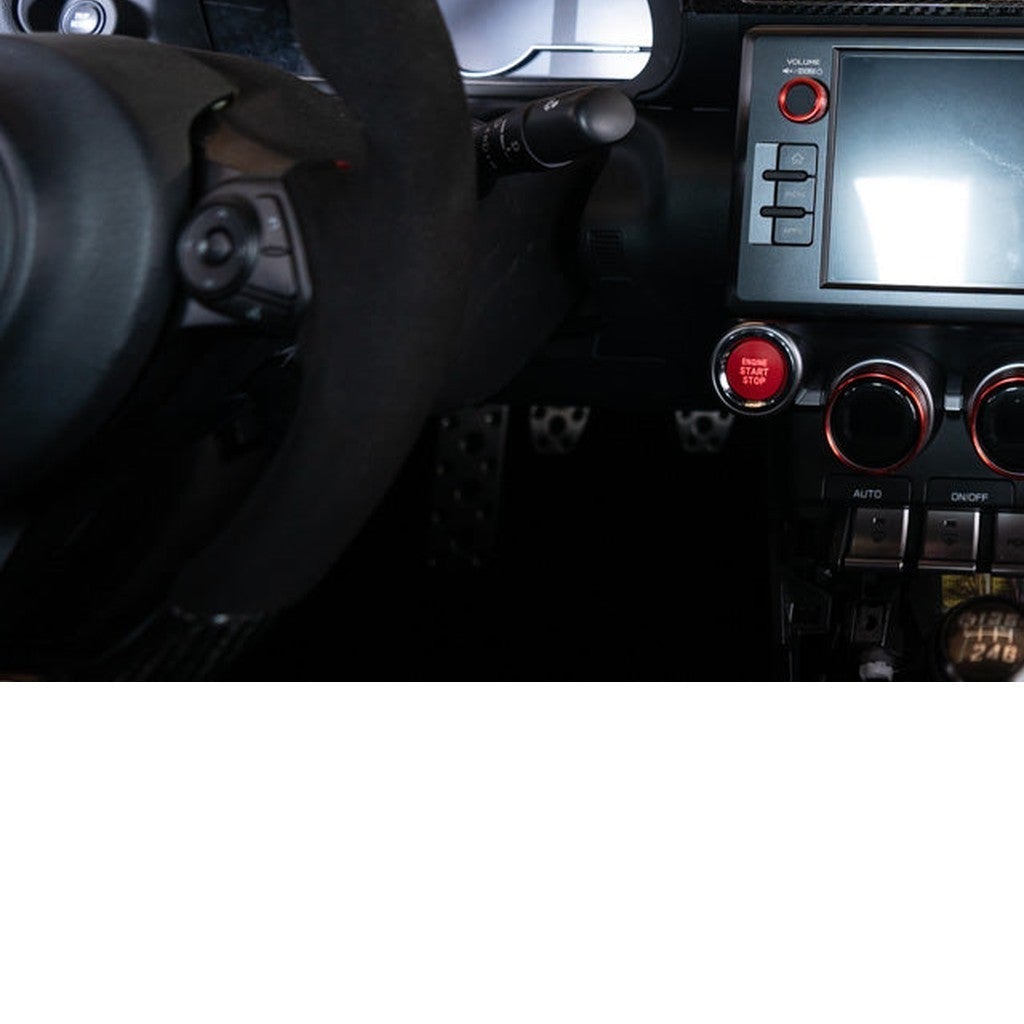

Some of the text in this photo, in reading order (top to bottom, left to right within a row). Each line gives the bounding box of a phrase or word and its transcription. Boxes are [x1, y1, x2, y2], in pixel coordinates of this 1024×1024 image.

[786, 58, 820, 66] VOLUME
[740, 366, 769, 376] START
[742, 376, 766, 386] STOP
[853, 488, 882, 500] AUTO
[951, 491, 989, 502] ON/OFF
